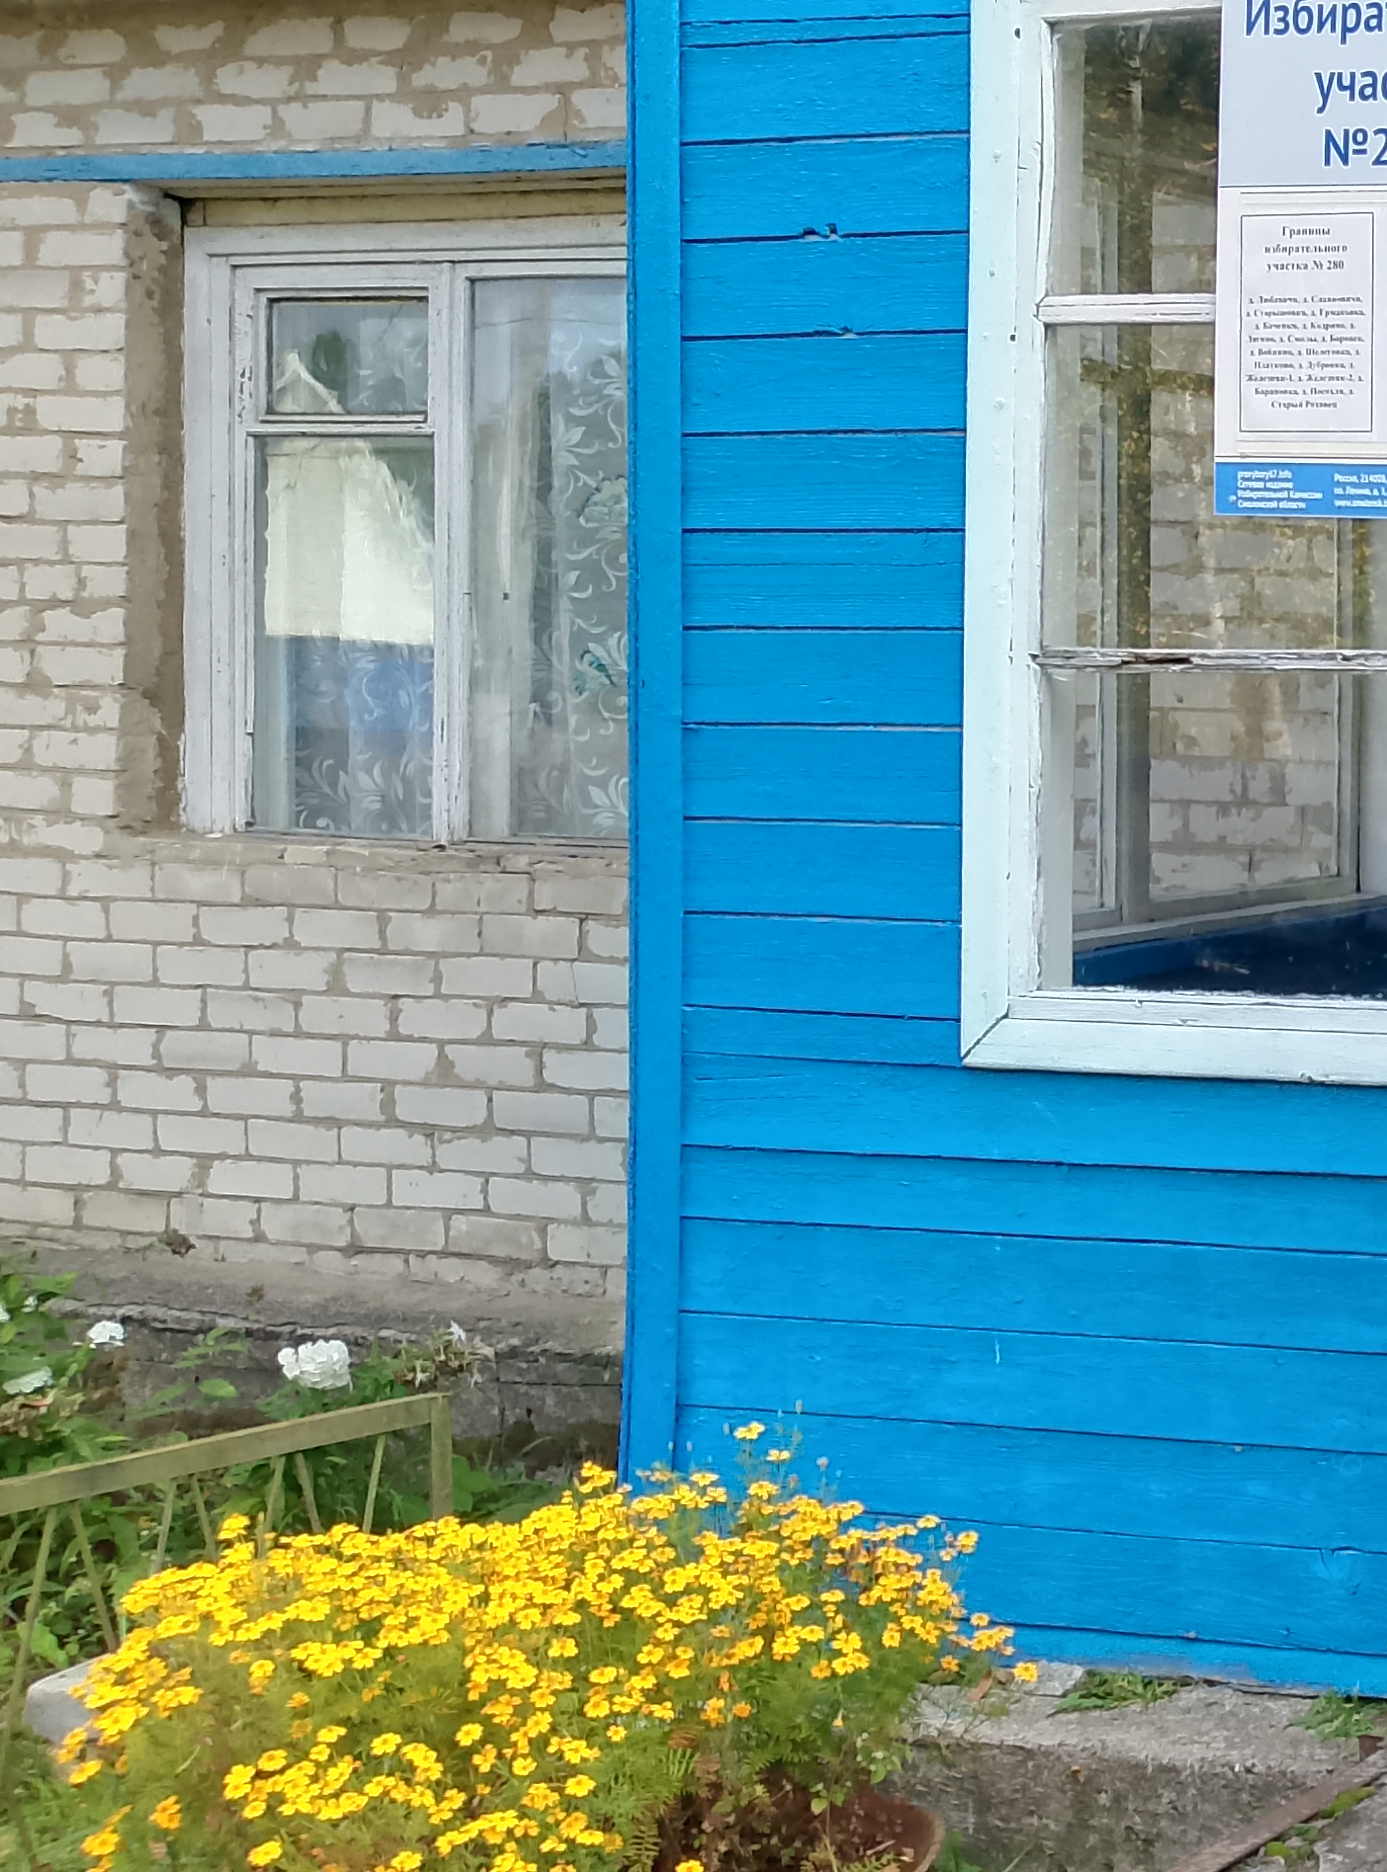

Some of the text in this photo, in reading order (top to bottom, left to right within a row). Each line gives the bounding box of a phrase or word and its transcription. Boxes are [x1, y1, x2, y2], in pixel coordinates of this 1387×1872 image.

[1282, 226, 1331, 239] Границы
[1264, 244, 1348, 256] избирательного
[1267, 262, 1309, 273] участка
[1327, 260, 1344, 270] 280
